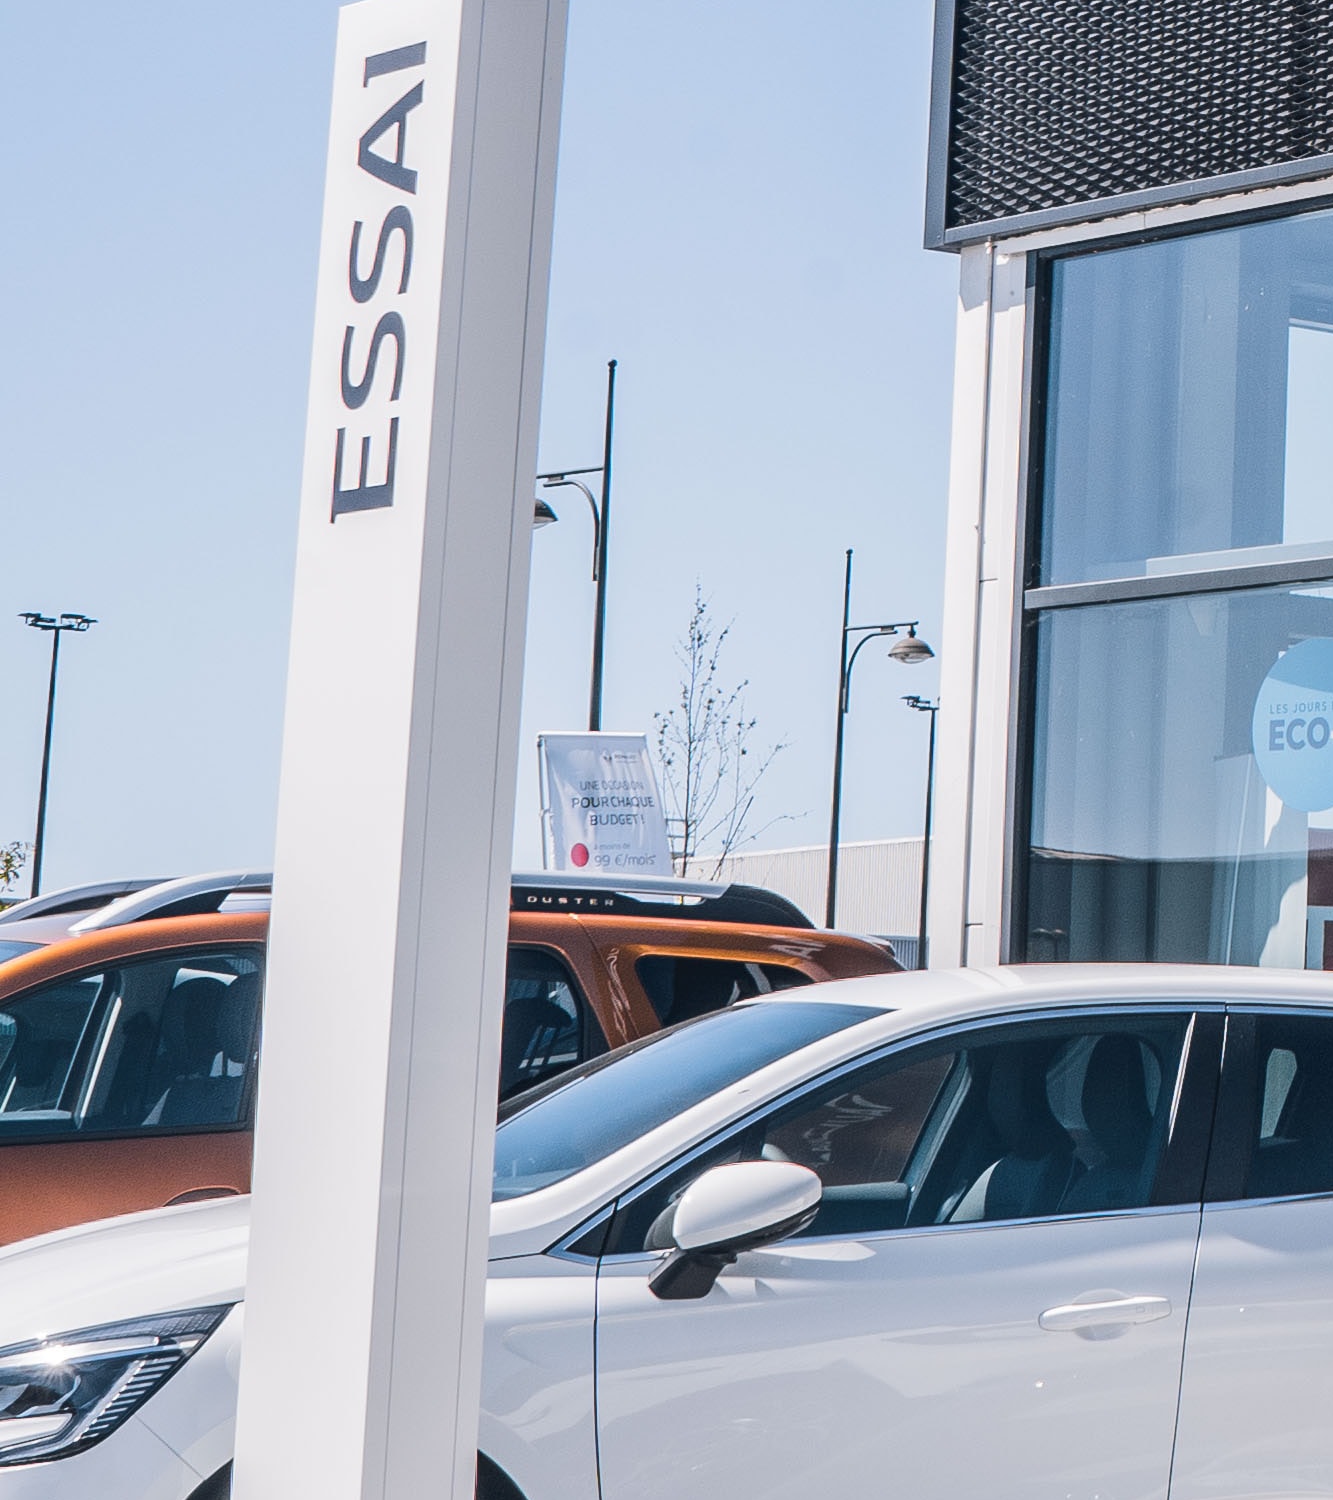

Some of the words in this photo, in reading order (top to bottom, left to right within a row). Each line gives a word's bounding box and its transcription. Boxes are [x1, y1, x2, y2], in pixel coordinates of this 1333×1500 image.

[329, 40, 427, 524] ESSAI
[1269, 703, 1289, 715] LES
[1293, 700, 1327, 714] JOURS
[571, 796, 610, 809] POUR
[610, 795, 655, 808] CHAQUE
[589, 813, 638, 826] BUDGET
[527, 895, 614, 907] DUSTER
